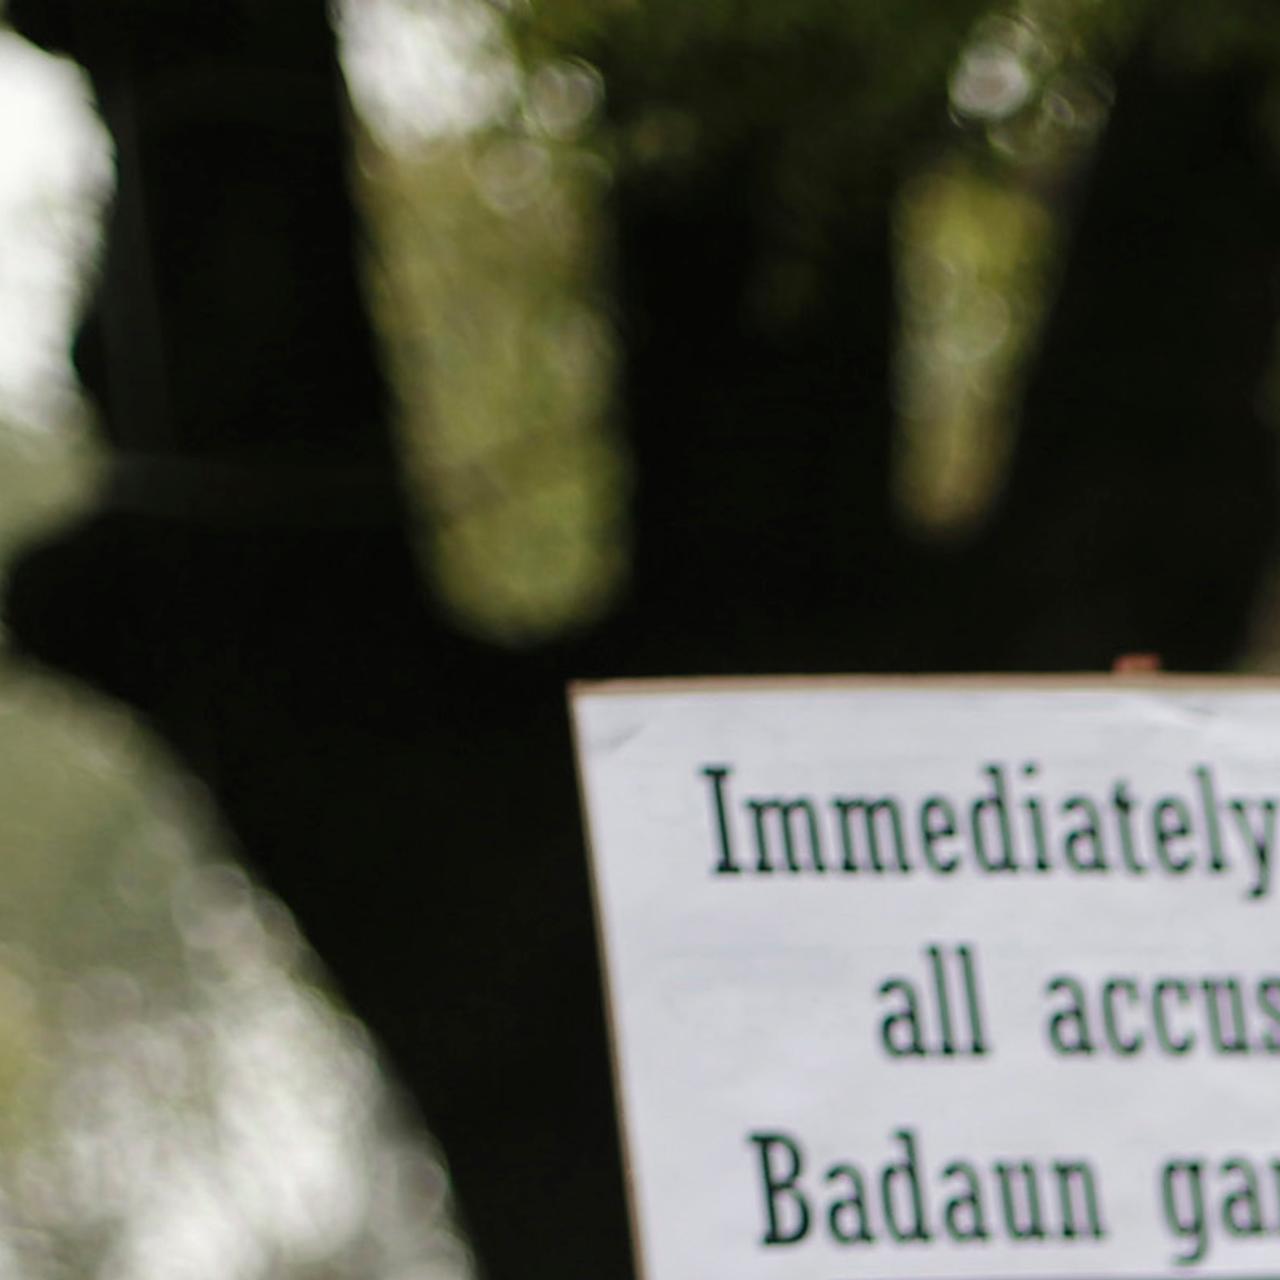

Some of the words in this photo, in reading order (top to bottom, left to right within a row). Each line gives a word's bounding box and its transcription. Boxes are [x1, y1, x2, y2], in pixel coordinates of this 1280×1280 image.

[700, 764, 1280, 901] Immediately
[875, 944, 989, 1060] all
[748, 1131, 1107, 1249] Badaun
